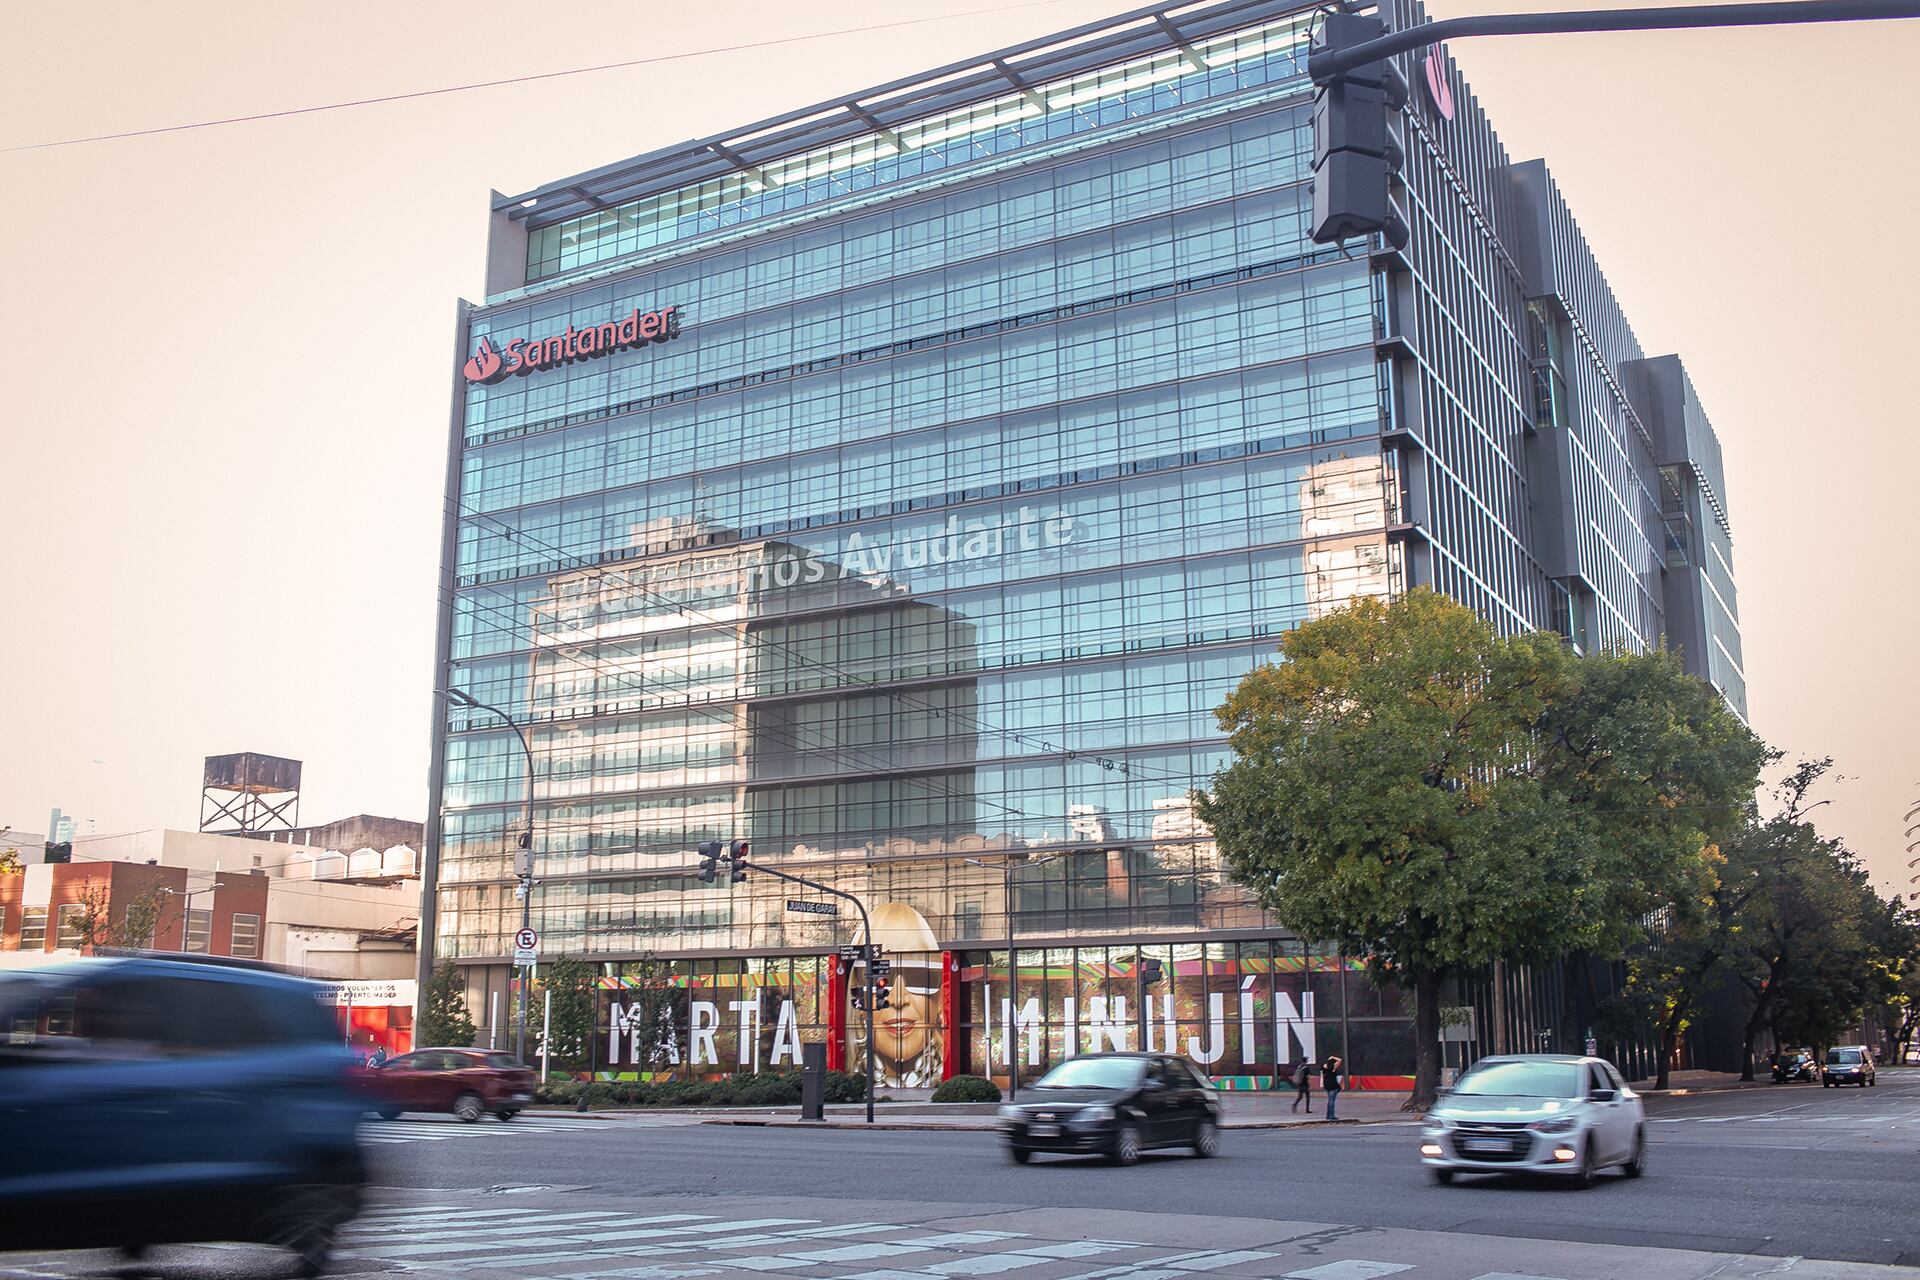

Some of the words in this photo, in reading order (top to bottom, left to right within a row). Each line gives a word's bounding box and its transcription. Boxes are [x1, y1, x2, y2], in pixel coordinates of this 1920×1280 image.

[506, 306, 676, 374] Santander
[839, 505, 1074, 590] Ayudarte
[609, 1000, 803, 1065] MARTA
[1001, 975, 1317, 1065] MINUJÍN
